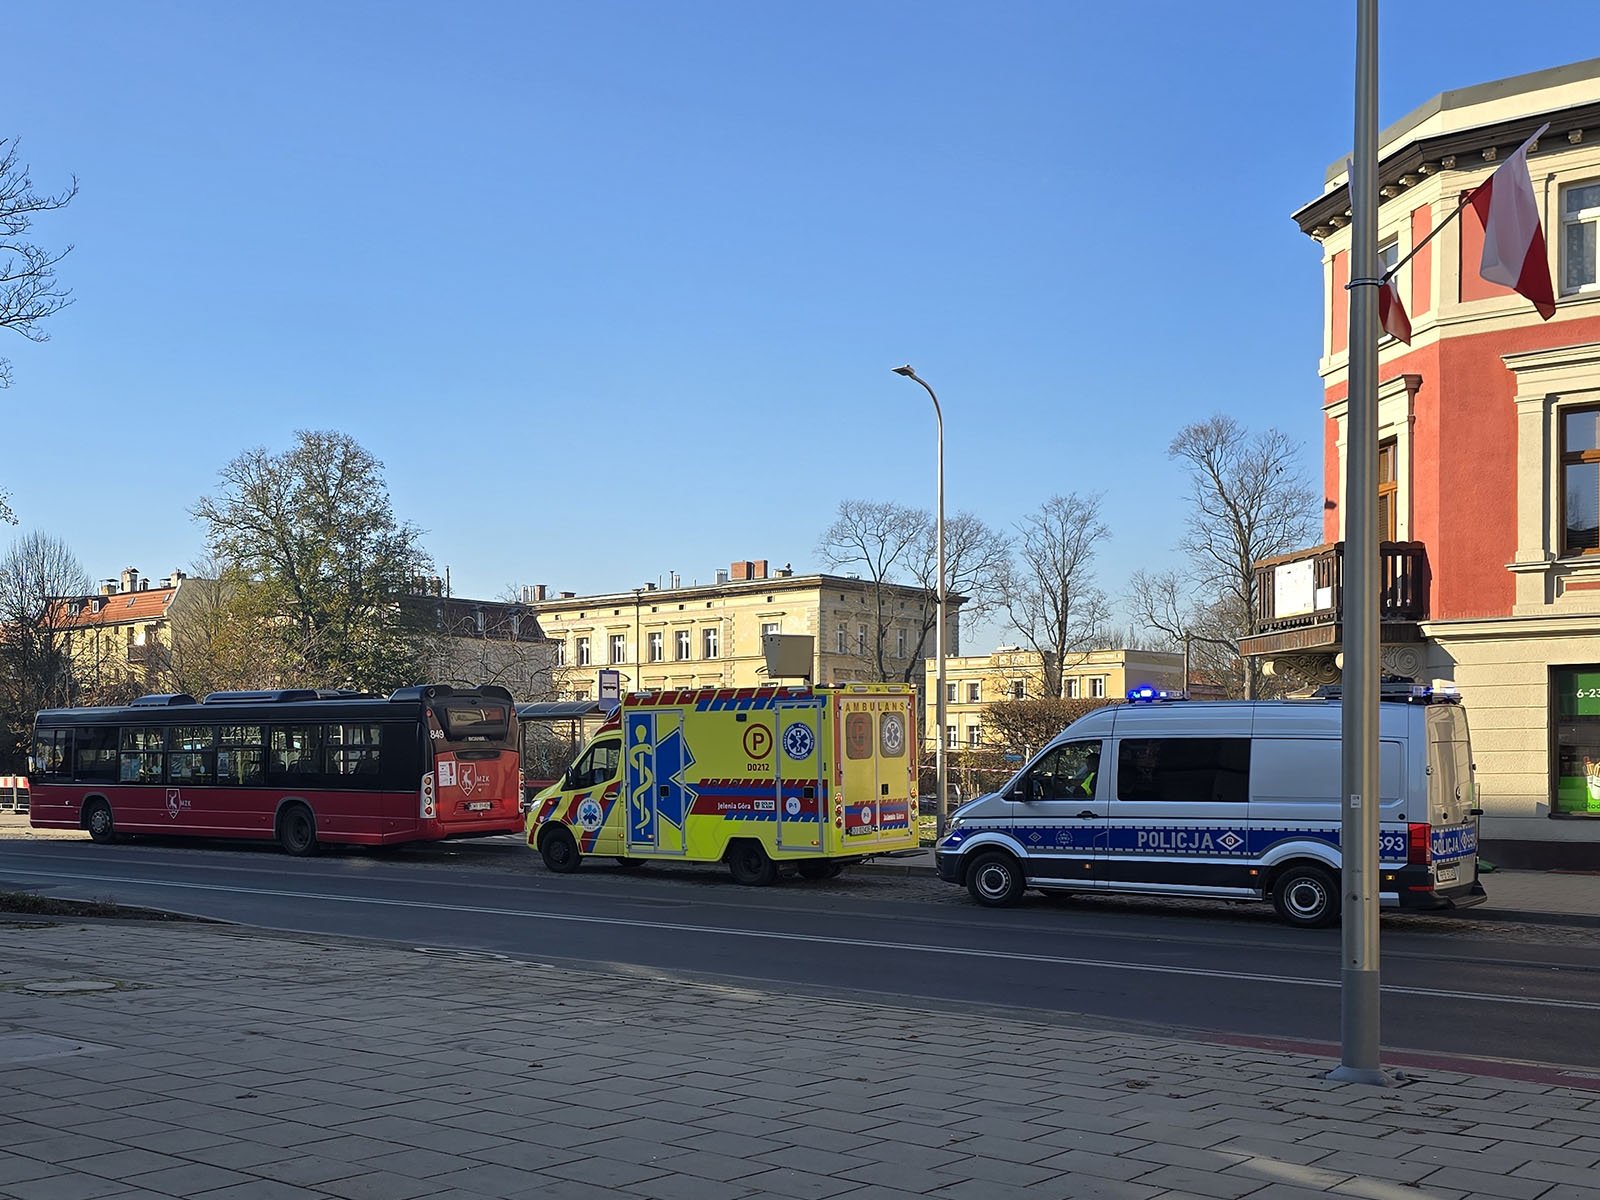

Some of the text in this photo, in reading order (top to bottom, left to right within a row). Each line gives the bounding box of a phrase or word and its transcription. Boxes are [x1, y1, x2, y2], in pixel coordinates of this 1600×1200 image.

[845, 702, 905, 711] AMBULANS
[430, 729, 444, 739] 849
[753, 733, 764, 751] P
[476, 775, 490, 783] MZK
[717, 802, 736, 810] Jelenia
[737, 801, 751, 809] Góra
[1137, 831, 1215, 849] POLICJA
[1433, 836, 1459, 854] POLICJA
